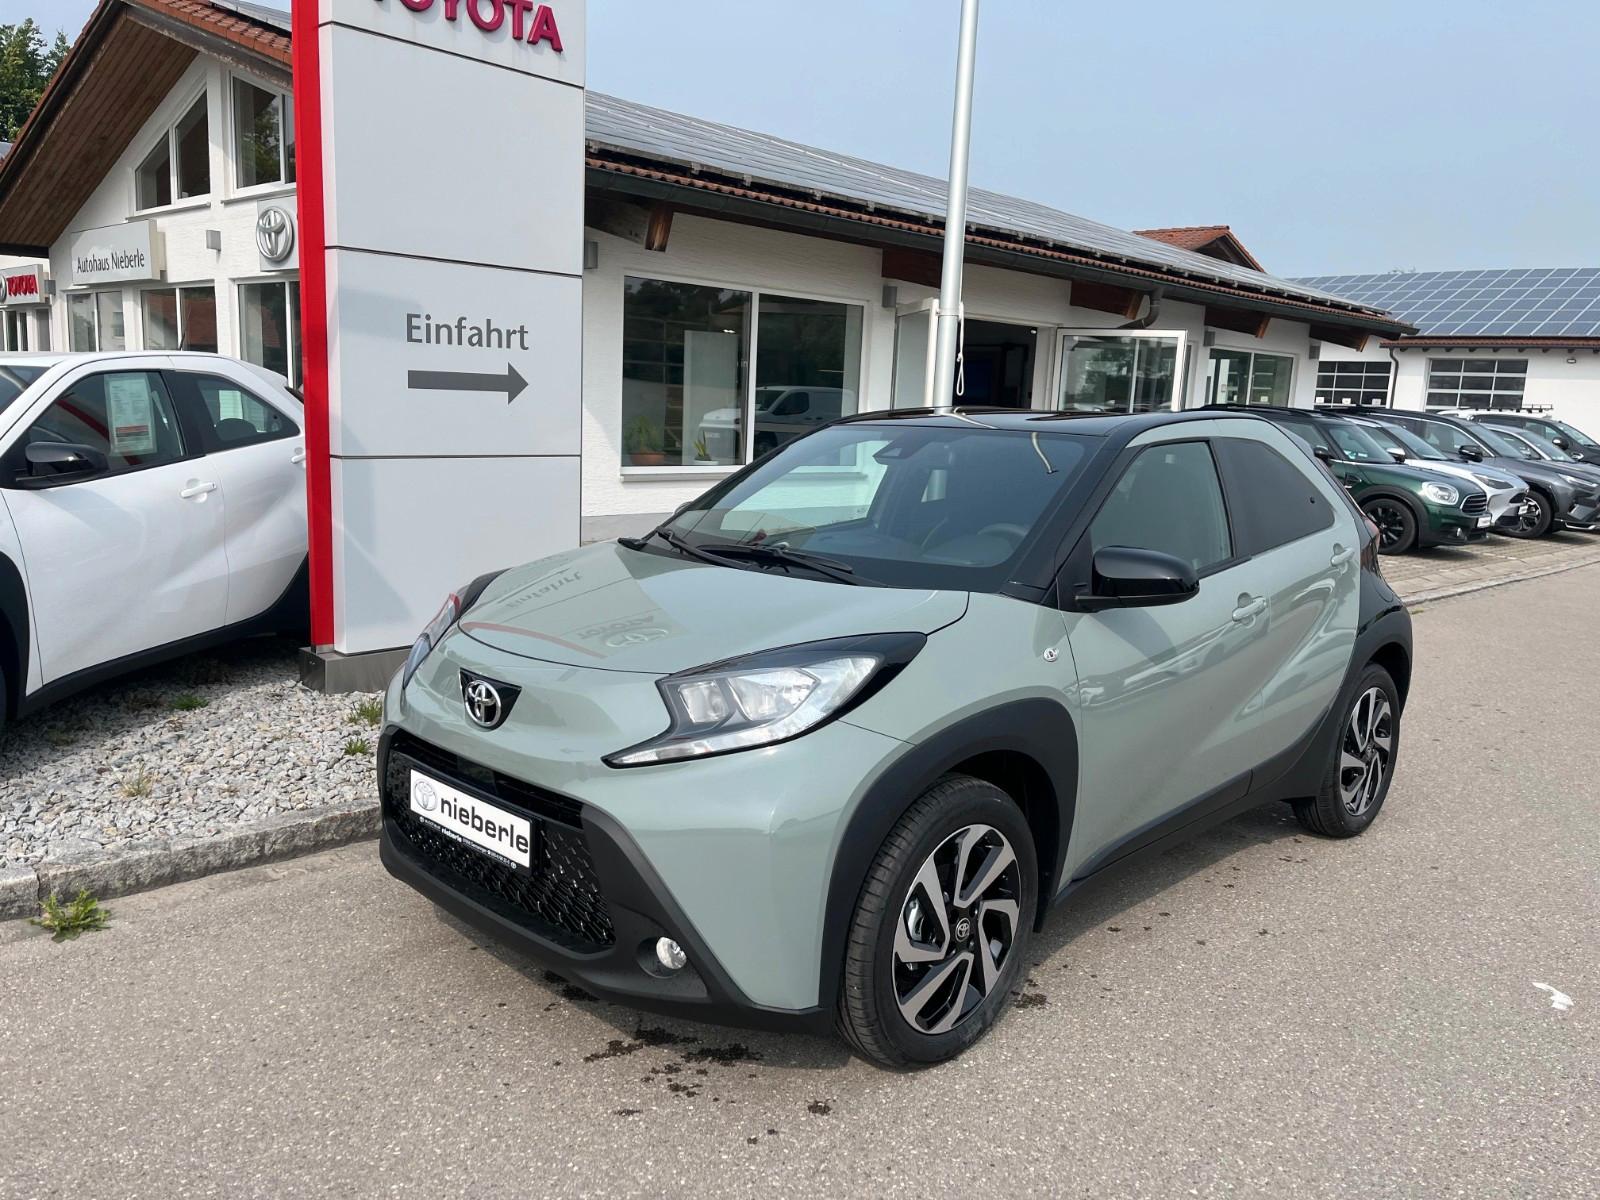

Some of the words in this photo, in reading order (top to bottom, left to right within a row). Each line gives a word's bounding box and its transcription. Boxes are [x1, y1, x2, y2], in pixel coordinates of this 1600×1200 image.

[77, 254, 110, 273] Autohaus
[111, 248, 145, 269] Nieberle
[406, 313, 529, 350] Einfahrt
[441, 798, 529, 854] nieberle
